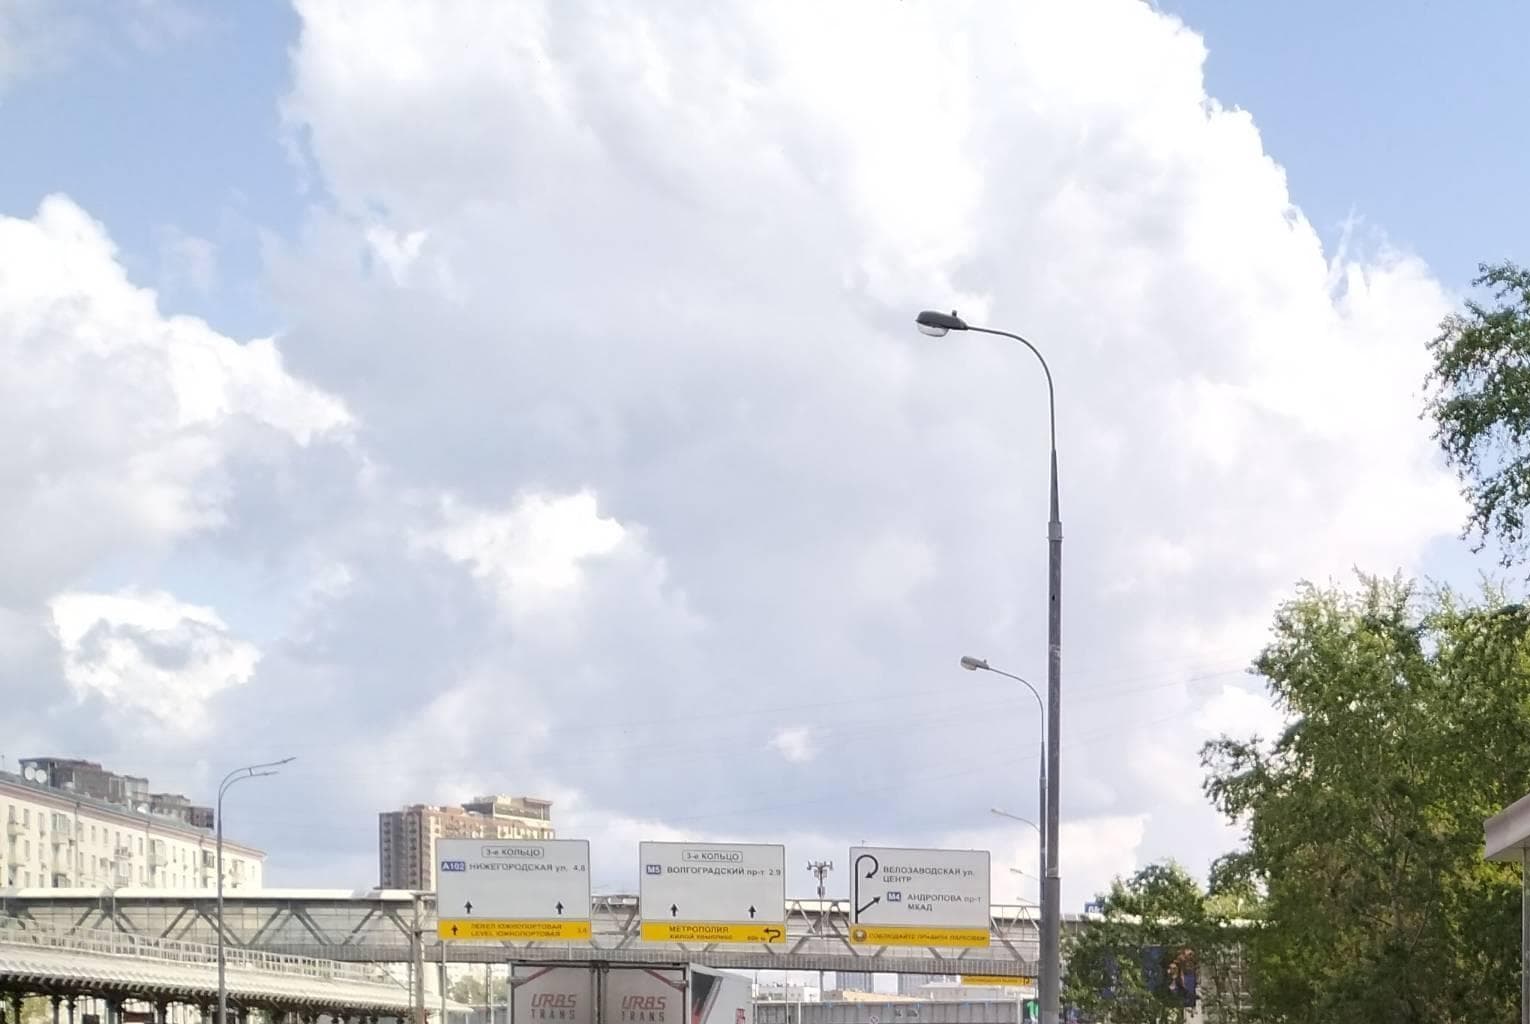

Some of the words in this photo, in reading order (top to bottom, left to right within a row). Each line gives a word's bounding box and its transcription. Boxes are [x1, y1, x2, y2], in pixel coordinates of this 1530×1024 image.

[502, 848, 541, 858] КОЛЬЦО
[702, 853, 740, 863] КОЛЬЦО
[469, 863, 553, 872] НИЖЕГОРОДСКАЯ
[667, 866, 745, 876] ВОЛГОГРАДСКИЙ
[883, 866, 961, 876] ВЕЛОЗАВОДСКАЯ
[883, 875, 912, 883] ЦЕНТР
[907, 893, 962, 902] АНДРОПОВА
[907, 903, 933, 912] МКАД
[531, 993, 577, 1008] URBS
[621, 995, 667, 1010] URBS
[531, 1009, 576, 1020] TRANS
[621, 1010, 665, 1022] TRANS
